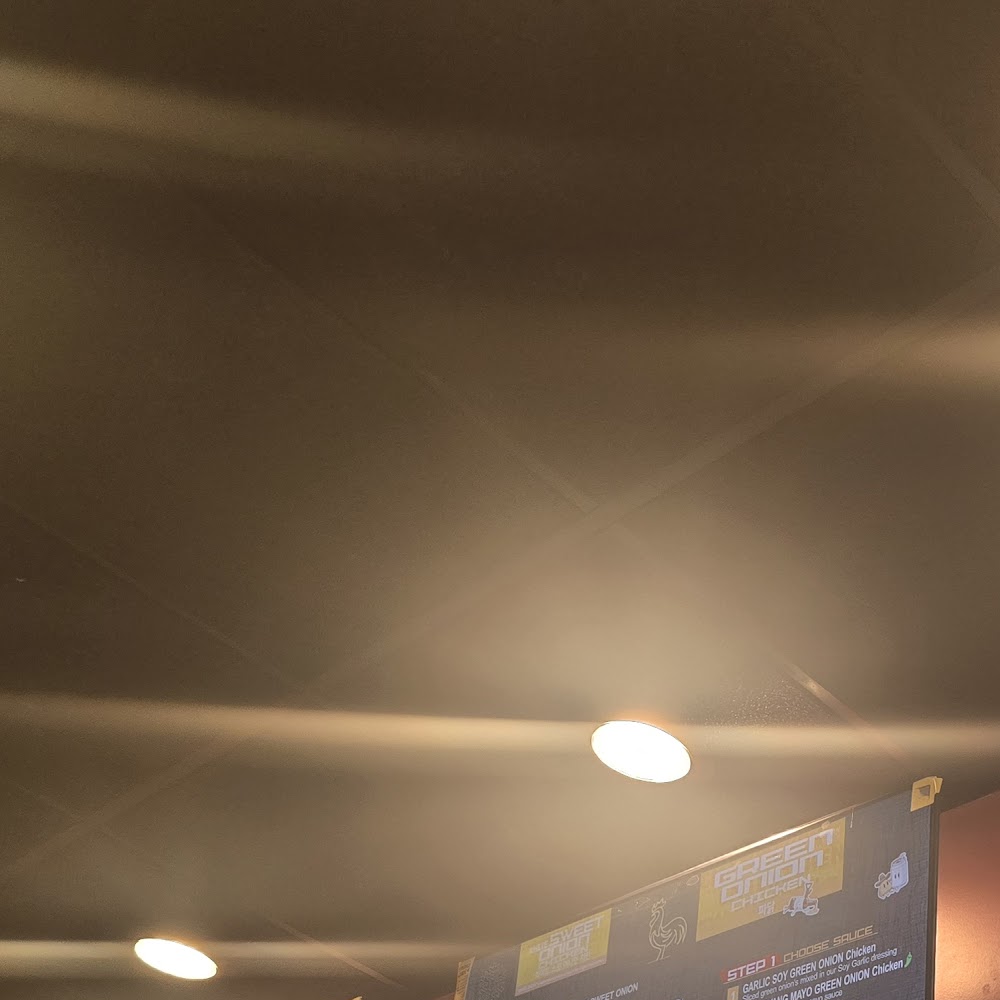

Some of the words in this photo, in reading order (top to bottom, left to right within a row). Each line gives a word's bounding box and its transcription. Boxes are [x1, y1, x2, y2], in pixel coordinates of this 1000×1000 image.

[714, 828, 834, 888] GREEN
[720, 850, 824, 904] ONION
[727, 959, 766, 982] STEP
[771, 955, 776, 967] 1
[783, 940, 830, 963] CHOOSE
[833, 925, 873, 945] SAUCE
[742, 976, 771, 993] GARLIC
[772, 970, 788, 984] SOY
[789, 961, 816, 979] GREEN
[818, 952, 843, 969] ONION
[846, 944, 876, 960] Chicken
[760, 987, 777, 998] green
[826, 968, 837, 976] our
[838, 963, 850, 974] Soy
[871, 948, 898, 962] dressing
[814, 977, 842, 994] GREEN
[844, 968, 870, 985] ONION
[872, 959, 904, 977] Chicken
[615, 982, 638, 998] ONION
